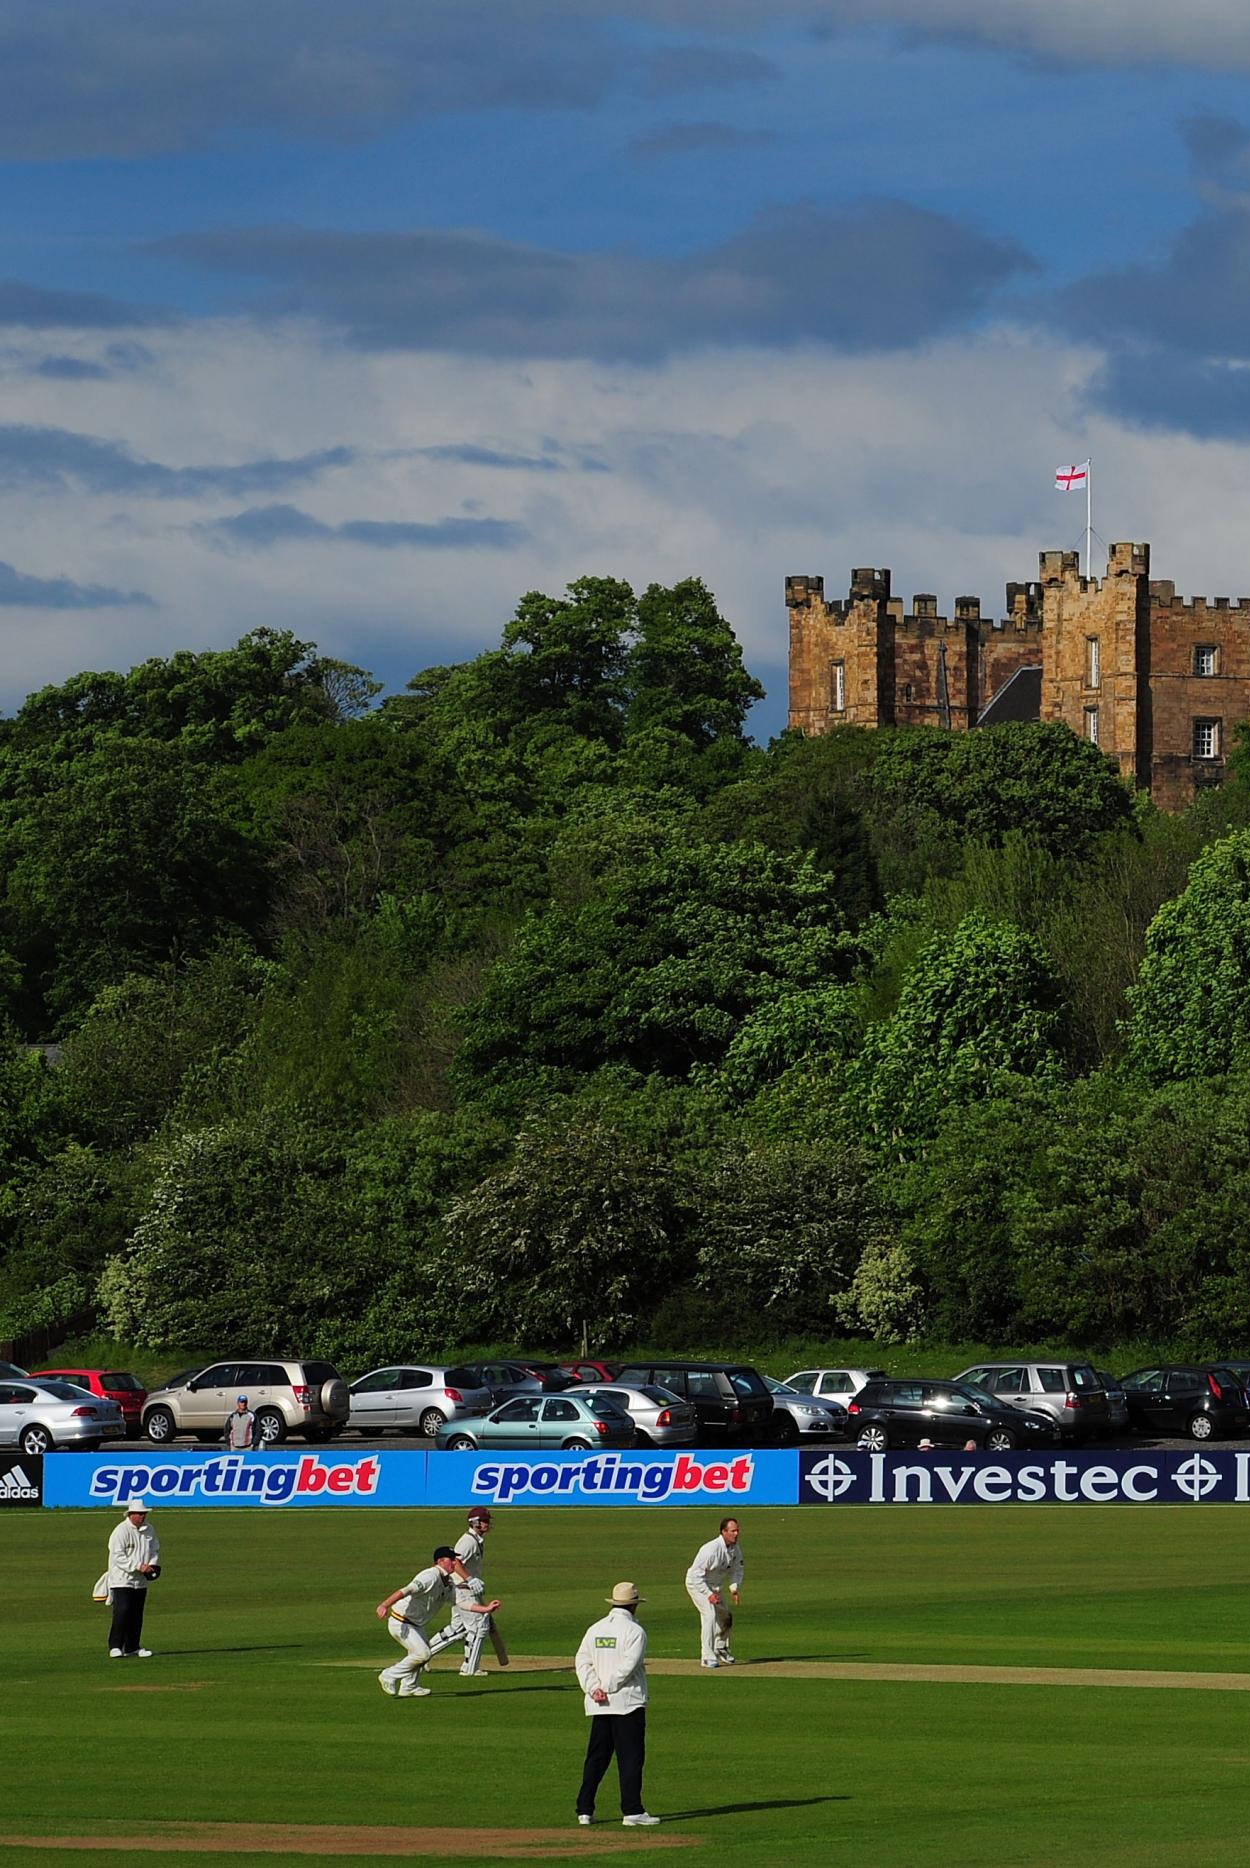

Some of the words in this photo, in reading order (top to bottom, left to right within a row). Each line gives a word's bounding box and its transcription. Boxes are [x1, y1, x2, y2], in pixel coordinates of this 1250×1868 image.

[91, 1456, 379, 1503] sportingbet
[473, 1455, 752, 1501] sportingbet
[869, 1453, 1158, 1502] Investec
